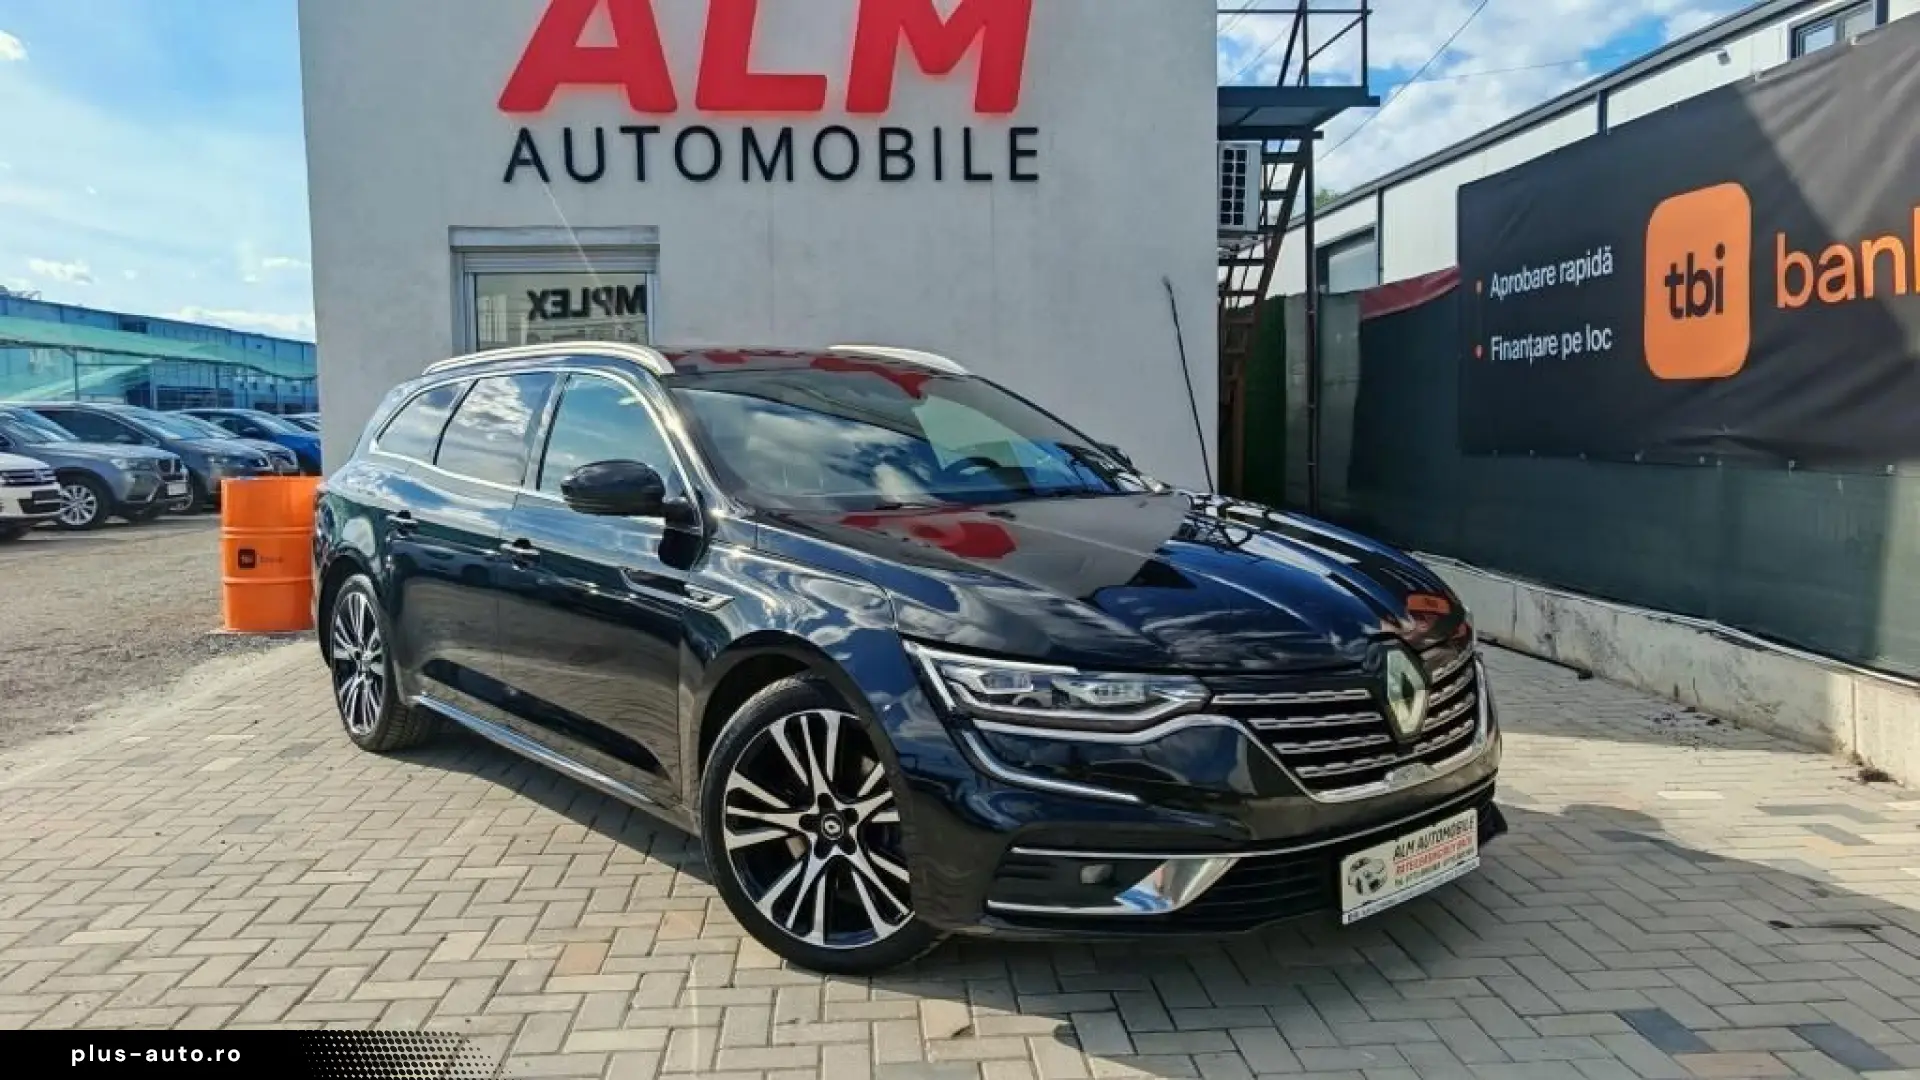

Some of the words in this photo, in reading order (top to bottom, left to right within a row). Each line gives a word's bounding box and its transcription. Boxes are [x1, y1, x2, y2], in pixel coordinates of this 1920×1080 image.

[497, 0, 1032, 113] ALM
[503, 126, 1039, 183] AUTOMOBILE
[1490, 264, 1557, 301] Aprobare
[1559, 245, 1613, 286] rapidă
[1664, 243, 1725, 320] tbi
[1562, 331, 1582, 360] pe
[1586, 323, 1612, 351] loc
